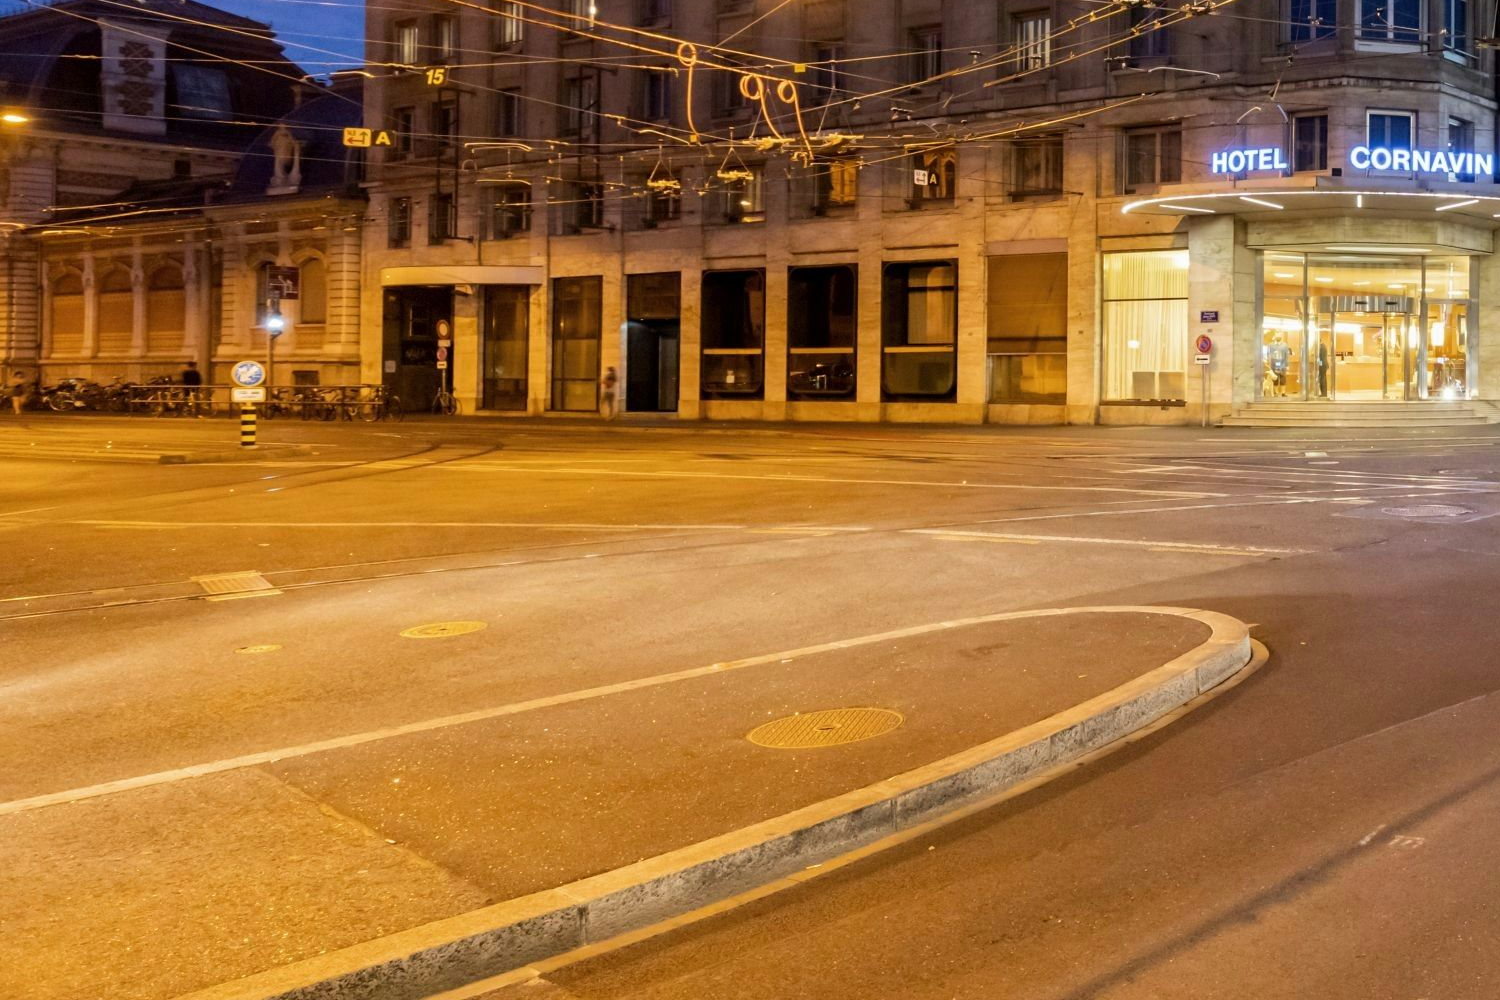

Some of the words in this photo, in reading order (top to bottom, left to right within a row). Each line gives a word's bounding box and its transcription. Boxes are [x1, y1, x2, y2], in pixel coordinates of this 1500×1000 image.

[425, 68, 445, 86] 15
[375, 131, 391, 145] A
[1212, 147, 1288, 173] HOTEL
[1350, 146, 1493, 175] CORNAVIN
[929, 173, 937, 185] A
